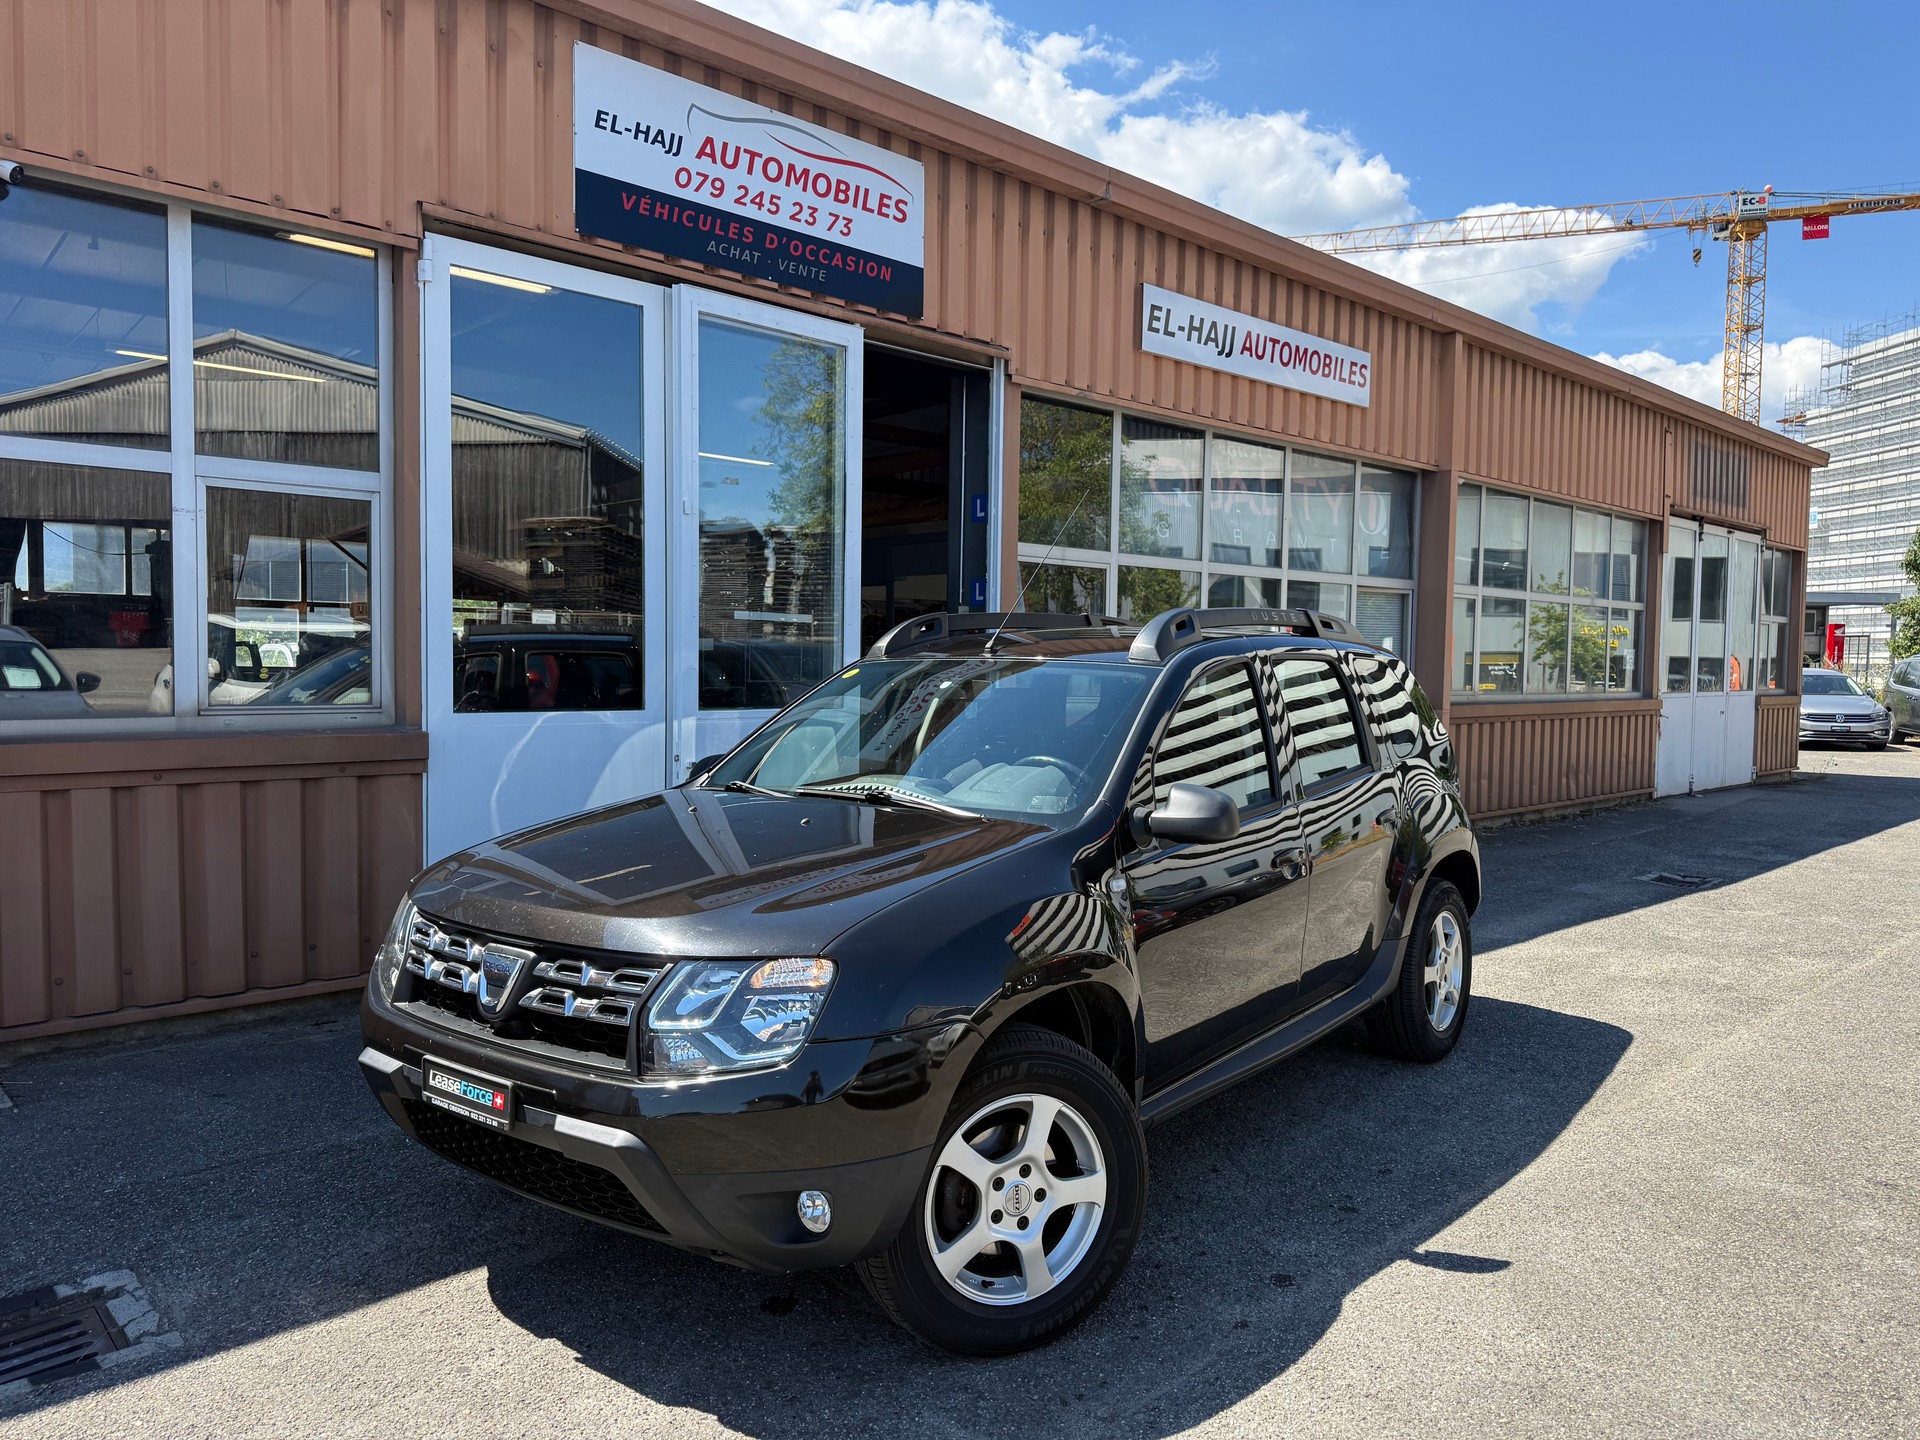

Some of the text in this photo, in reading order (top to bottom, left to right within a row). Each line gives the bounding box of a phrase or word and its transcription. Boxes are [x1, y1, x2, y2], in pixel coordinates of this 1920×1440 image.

[594, 109, 908, 224] EL-HAJJ AUTOMOBILES
[674, 167, 854, 238] 079 245 23 73
[1742, 196, 1767, 206] EC-B
[621, 192, 892, 282] VÉHICULES D'OCCASION
[707, 241, 827, 282] ACHAT VENTE
[1147, 303, 1368, 388] EL-HAJJ AUTOMOBILES
[976, 498, 985, 518] L
[1150, 456, 1346, 525] QUALTY
[1157, 521, 1390, 560] GRANTIE
[975, 582, 984, 601] L
[1250, 610, 1307, 624] DUSTER
[484, 960, 511, 975] DACIA
[429, 1069, 494, 1105] LeaseForce
